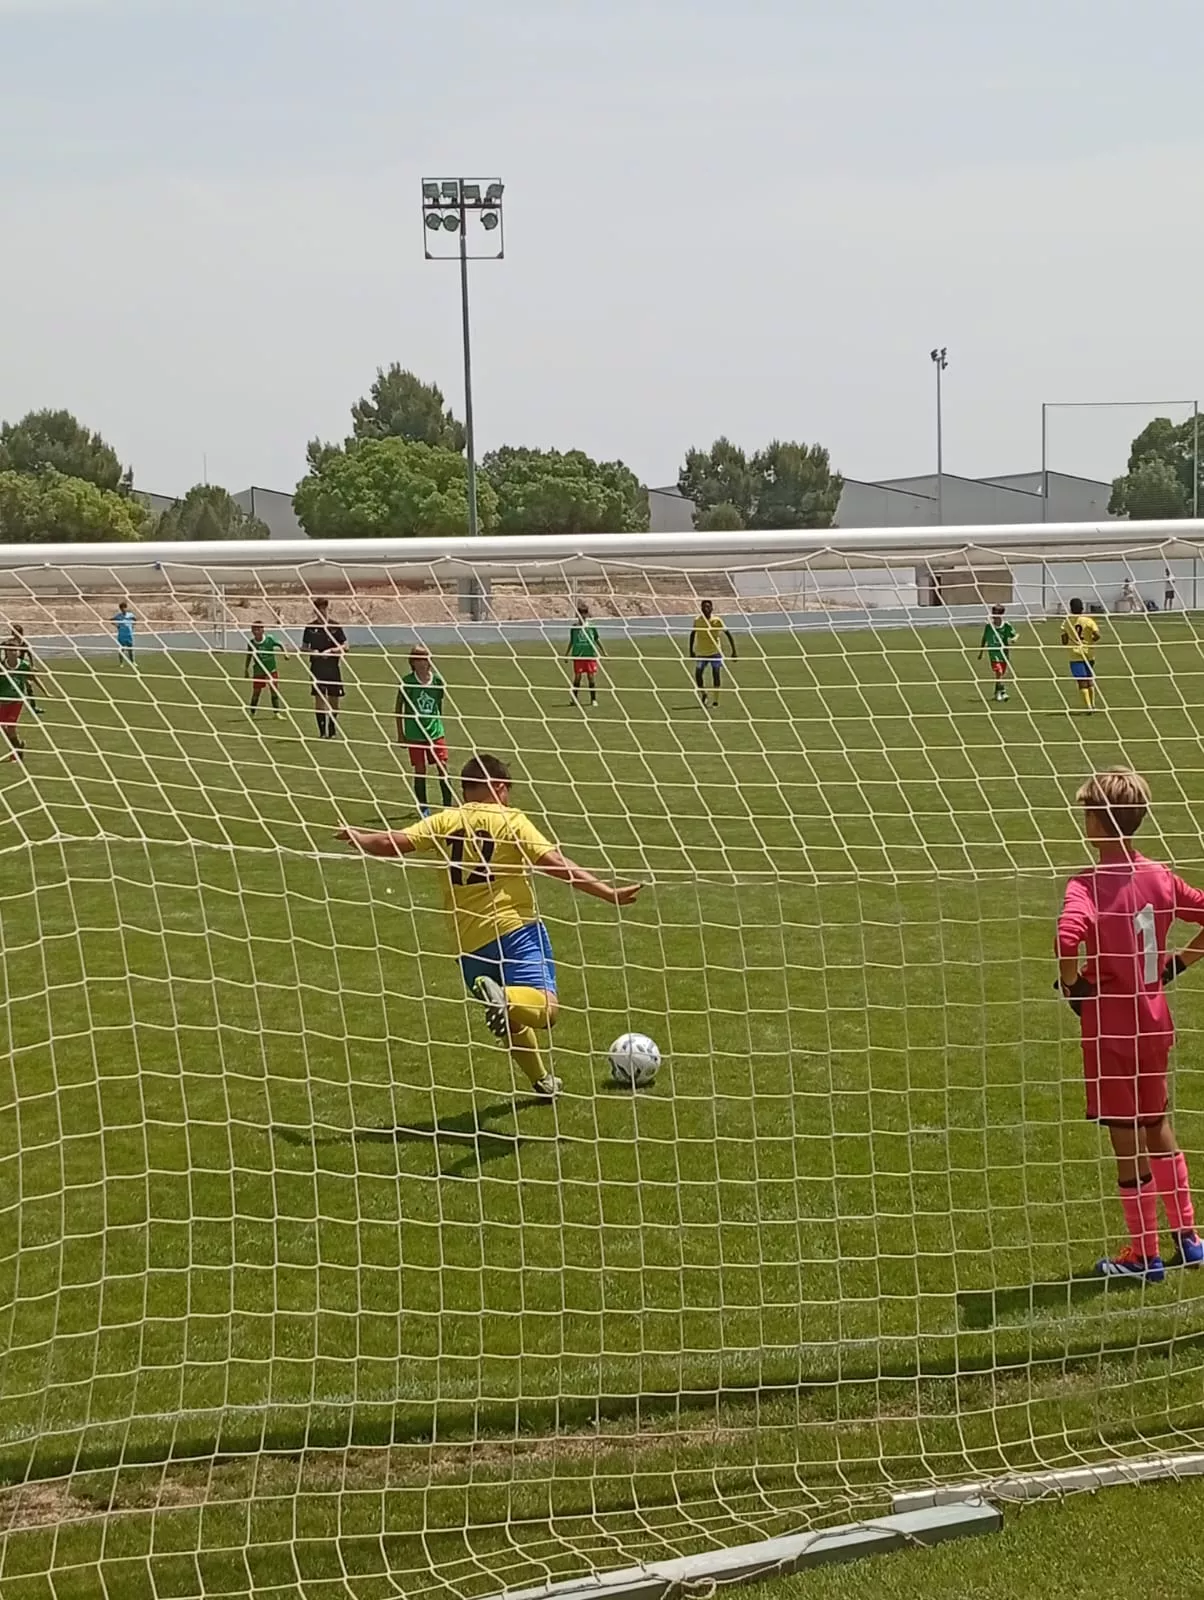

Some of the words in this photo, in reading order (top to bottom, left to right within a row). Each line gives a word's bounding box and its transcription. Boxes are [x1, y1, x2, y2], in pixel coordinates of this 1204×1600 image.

[1074, 624, 1084, 642] 2
[446, 828, 495, 885] 12
[1133, 903, 1158, 984] 1
